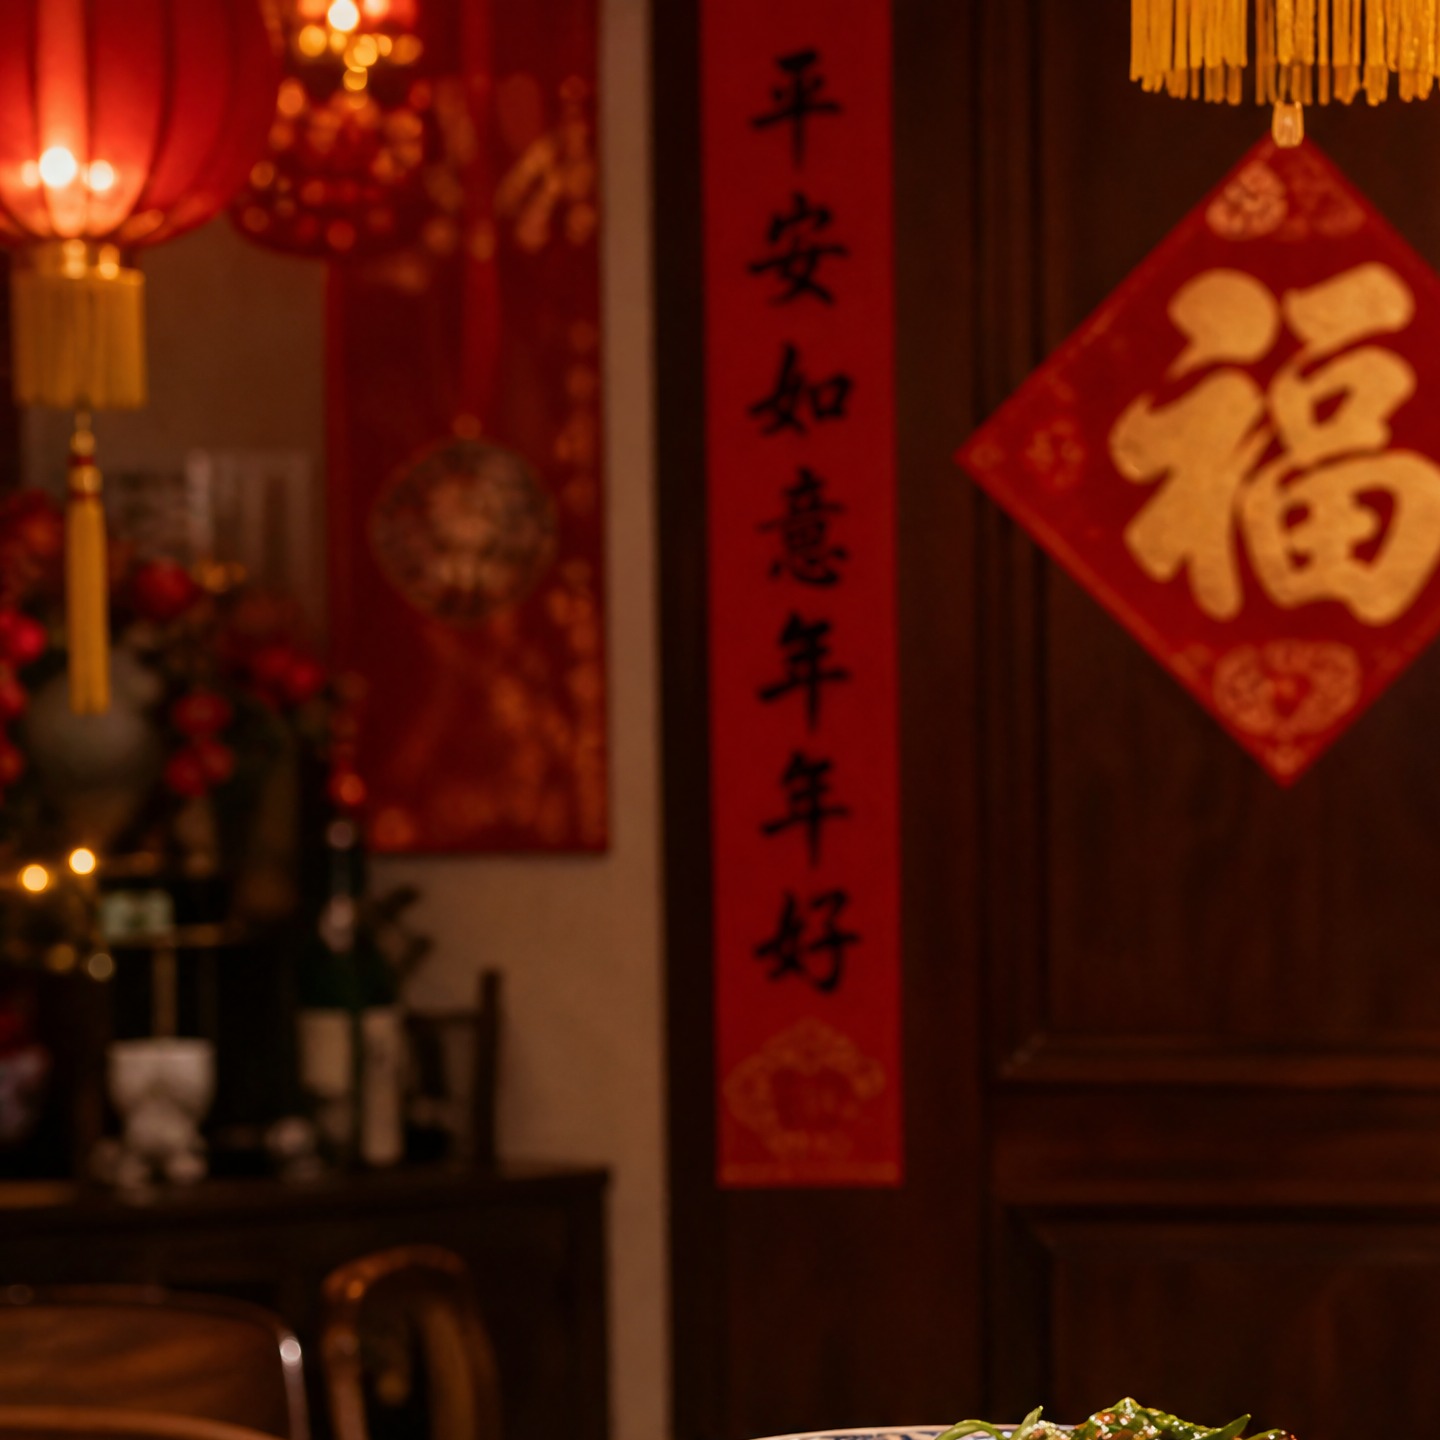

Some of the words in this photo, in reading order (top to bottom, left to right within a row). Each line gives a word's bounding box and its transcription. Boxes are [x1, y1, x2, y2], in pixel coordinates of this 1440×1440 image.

[745, 48, 862, 992] 平安如意年年好
